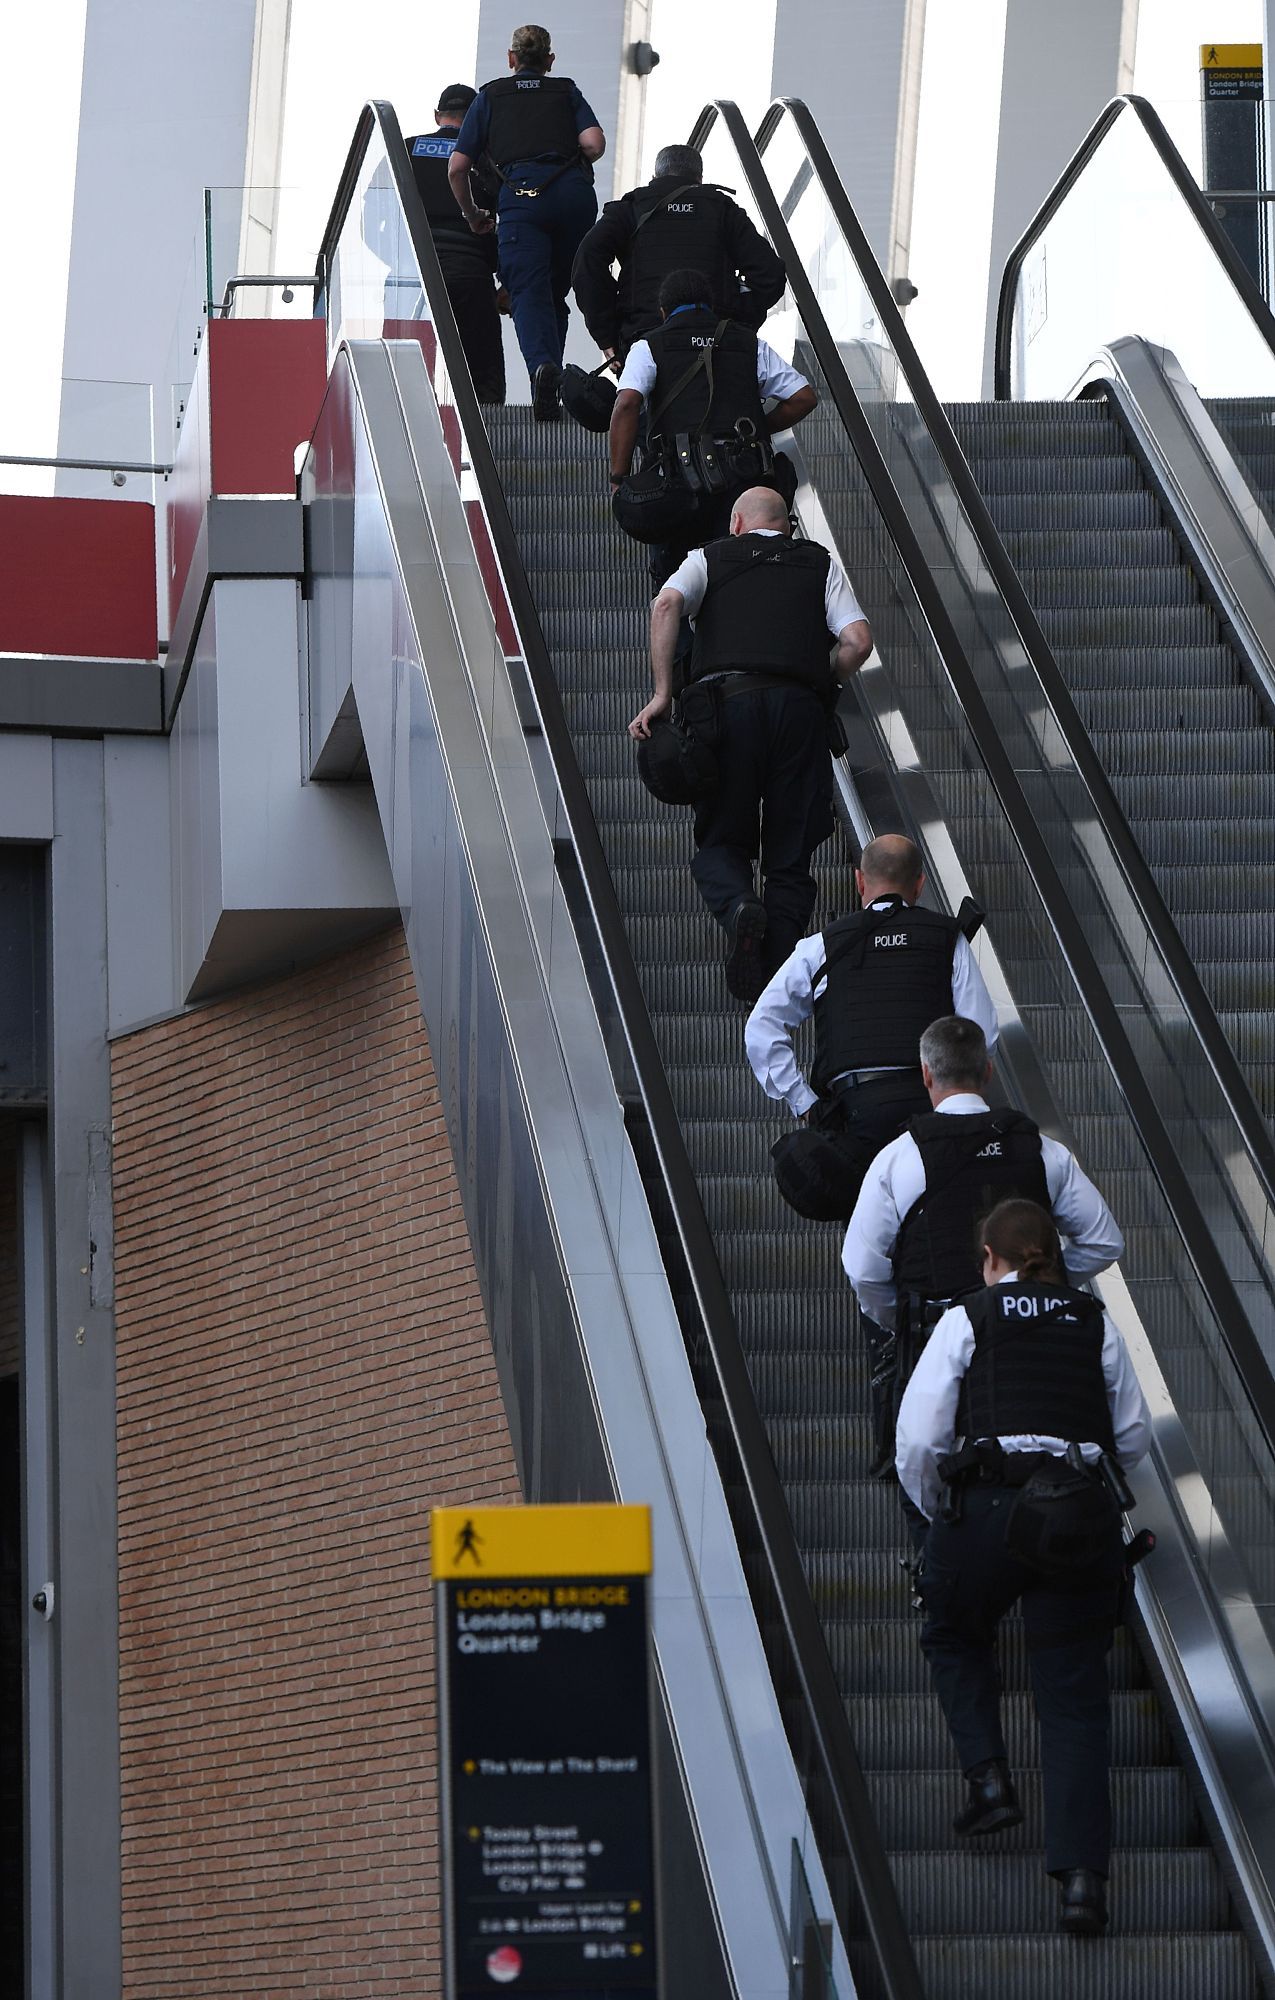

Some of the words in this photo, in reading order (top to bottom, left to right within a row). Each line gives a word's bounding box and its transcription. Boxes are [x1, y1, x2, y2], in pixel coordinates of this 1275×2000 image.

[416, 143, 452, 155] POLI
[667, 203, 693, 212] POLICE
[691, 336, 718, 347] POLIC
[874, 933, 907, 947] POLICE
[457, 1588, 548, 1608] LONDON
[554, 1586, 628, 1605] BRIDGE
[457, 1610, 536, 1631] London
[540, 1608, 606, 1633] Bridge
[457, 1632, 539, 1654] Quarter
[480, 1759, 507, 1774] The
[510, 1759, 545, 1773] View
[548, 1760, 563, 1773] at
[567, 1757, 594, 1772] The
[597, 1756, 637, 1773] Shard
[482, 1843, 537, 1858] London
[540, 1842, 586, 1857] Bridge
[482, 1860, 537, 1875] London
[540, 1859, 586, 1876] Bridge
[522, 1918, 577, 1932] London
[579, 1916, 625, 1933] Bridge
